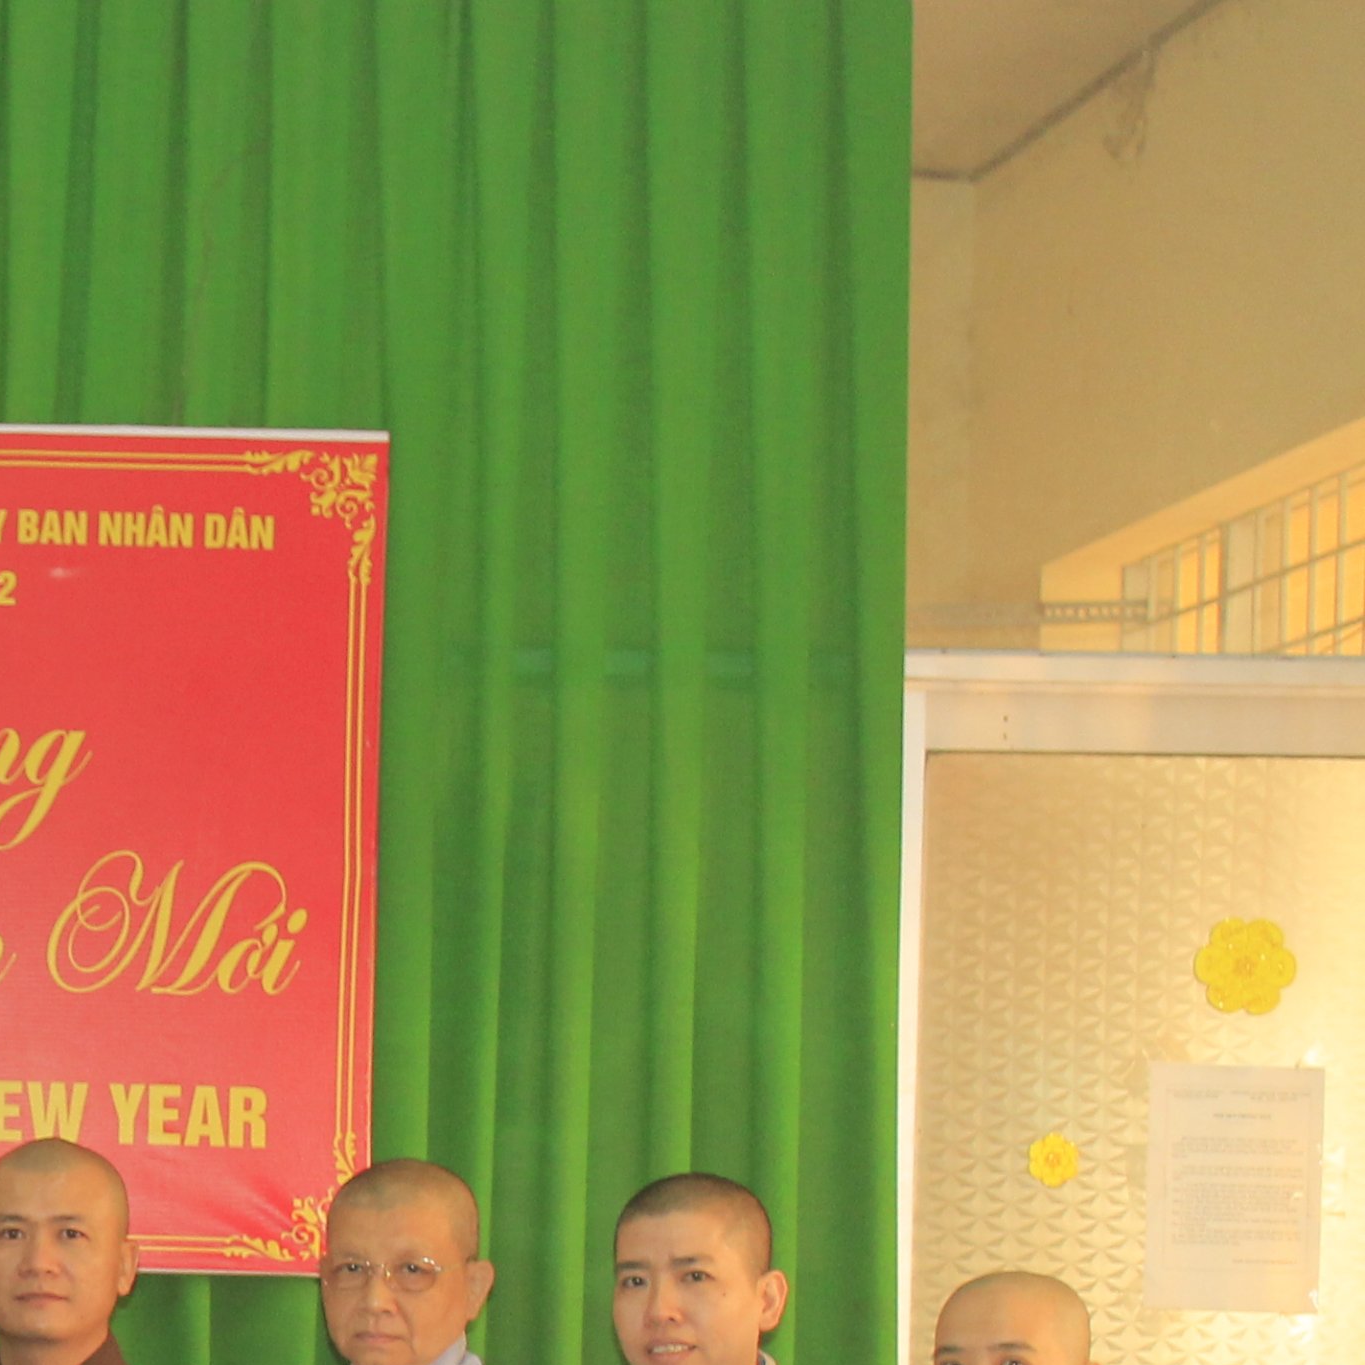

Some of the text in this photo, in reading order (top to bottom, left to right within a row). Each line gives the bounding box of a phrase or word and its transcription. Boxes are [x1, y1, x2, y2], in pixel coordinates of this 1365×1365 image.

[16, 508, 89, 546] BAN
[98, 504, 194, 548] NHÂN
[203, 507, 275, 550] DÂN
[46, 849, 309, 996] Mới
[109, 1081, 268, 1149] YEAR
